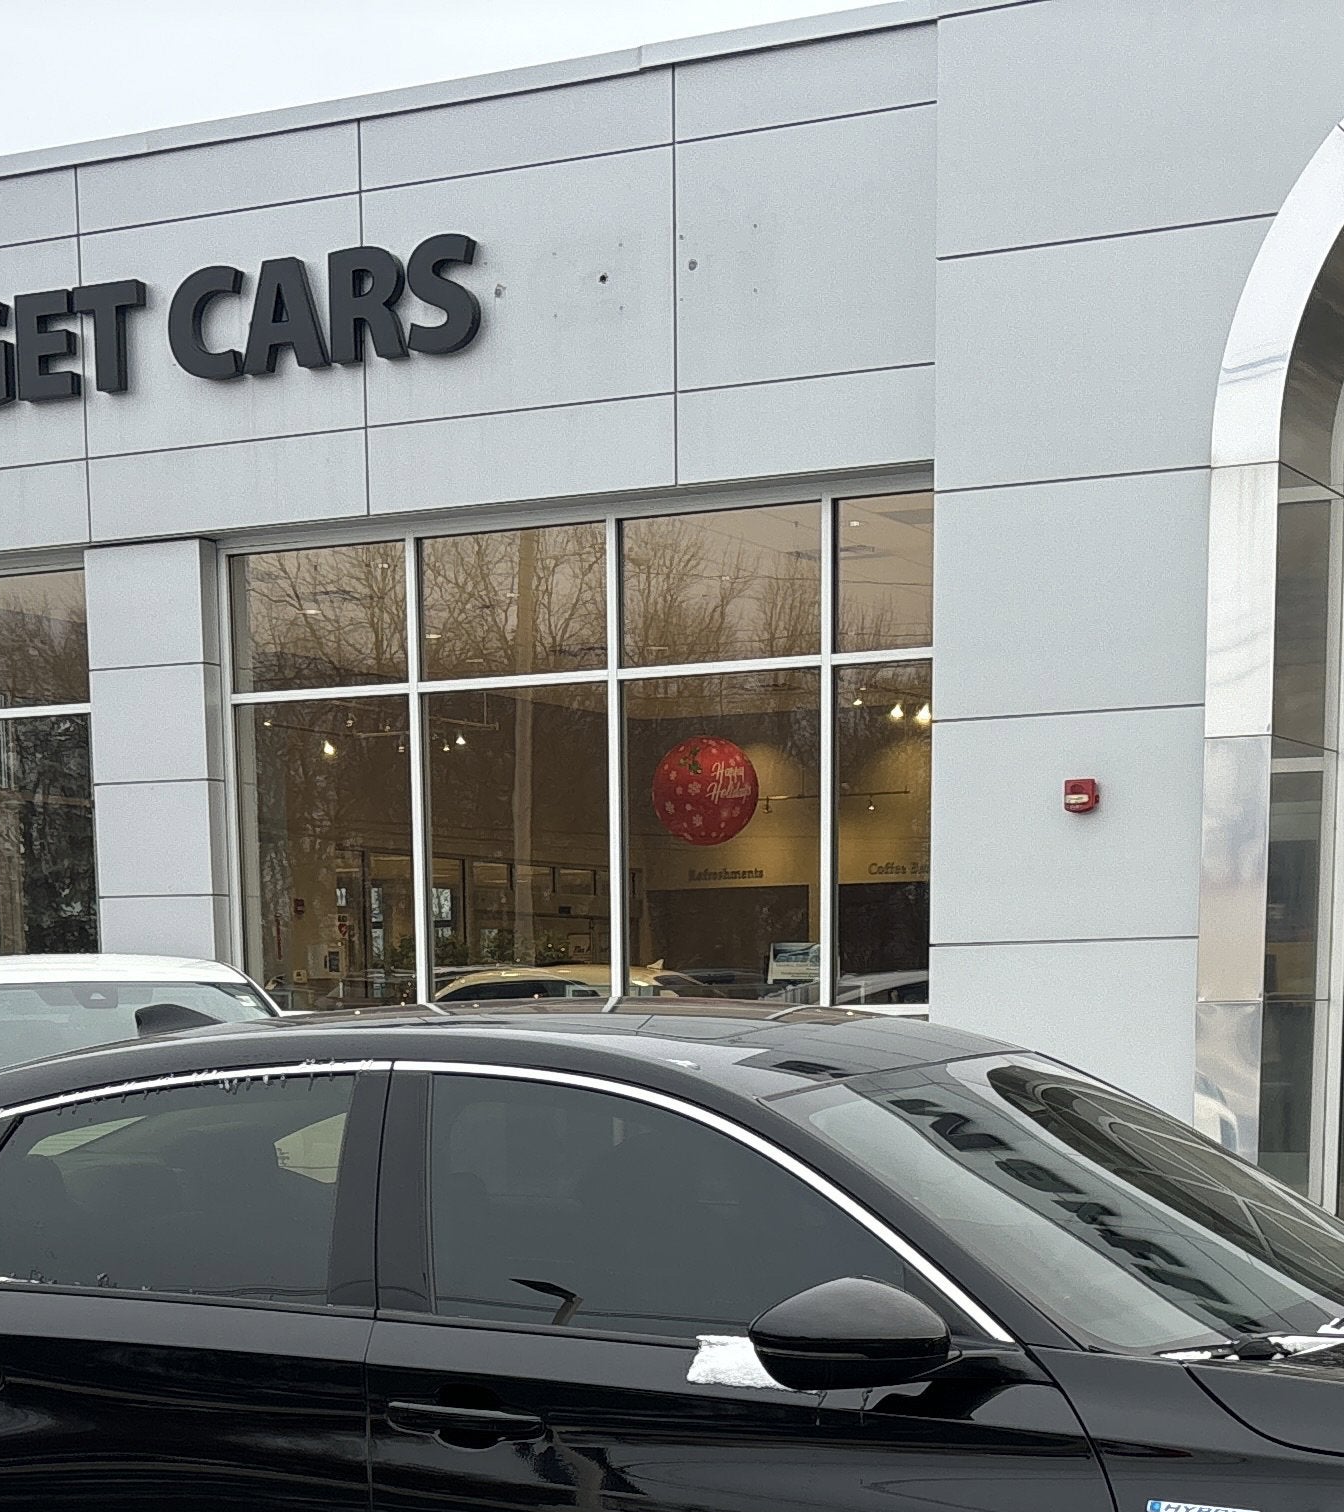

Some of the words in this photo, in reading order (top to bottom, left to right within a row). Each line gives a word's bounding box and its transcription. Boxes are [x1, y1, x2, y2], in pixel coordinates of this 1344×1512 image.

[168, 232, 481, 381] CARS
[711, 760, 745, 783] Happy
[688, 867, 764, 881] Refreshments
[867, 862, 907, 875] Coffee
